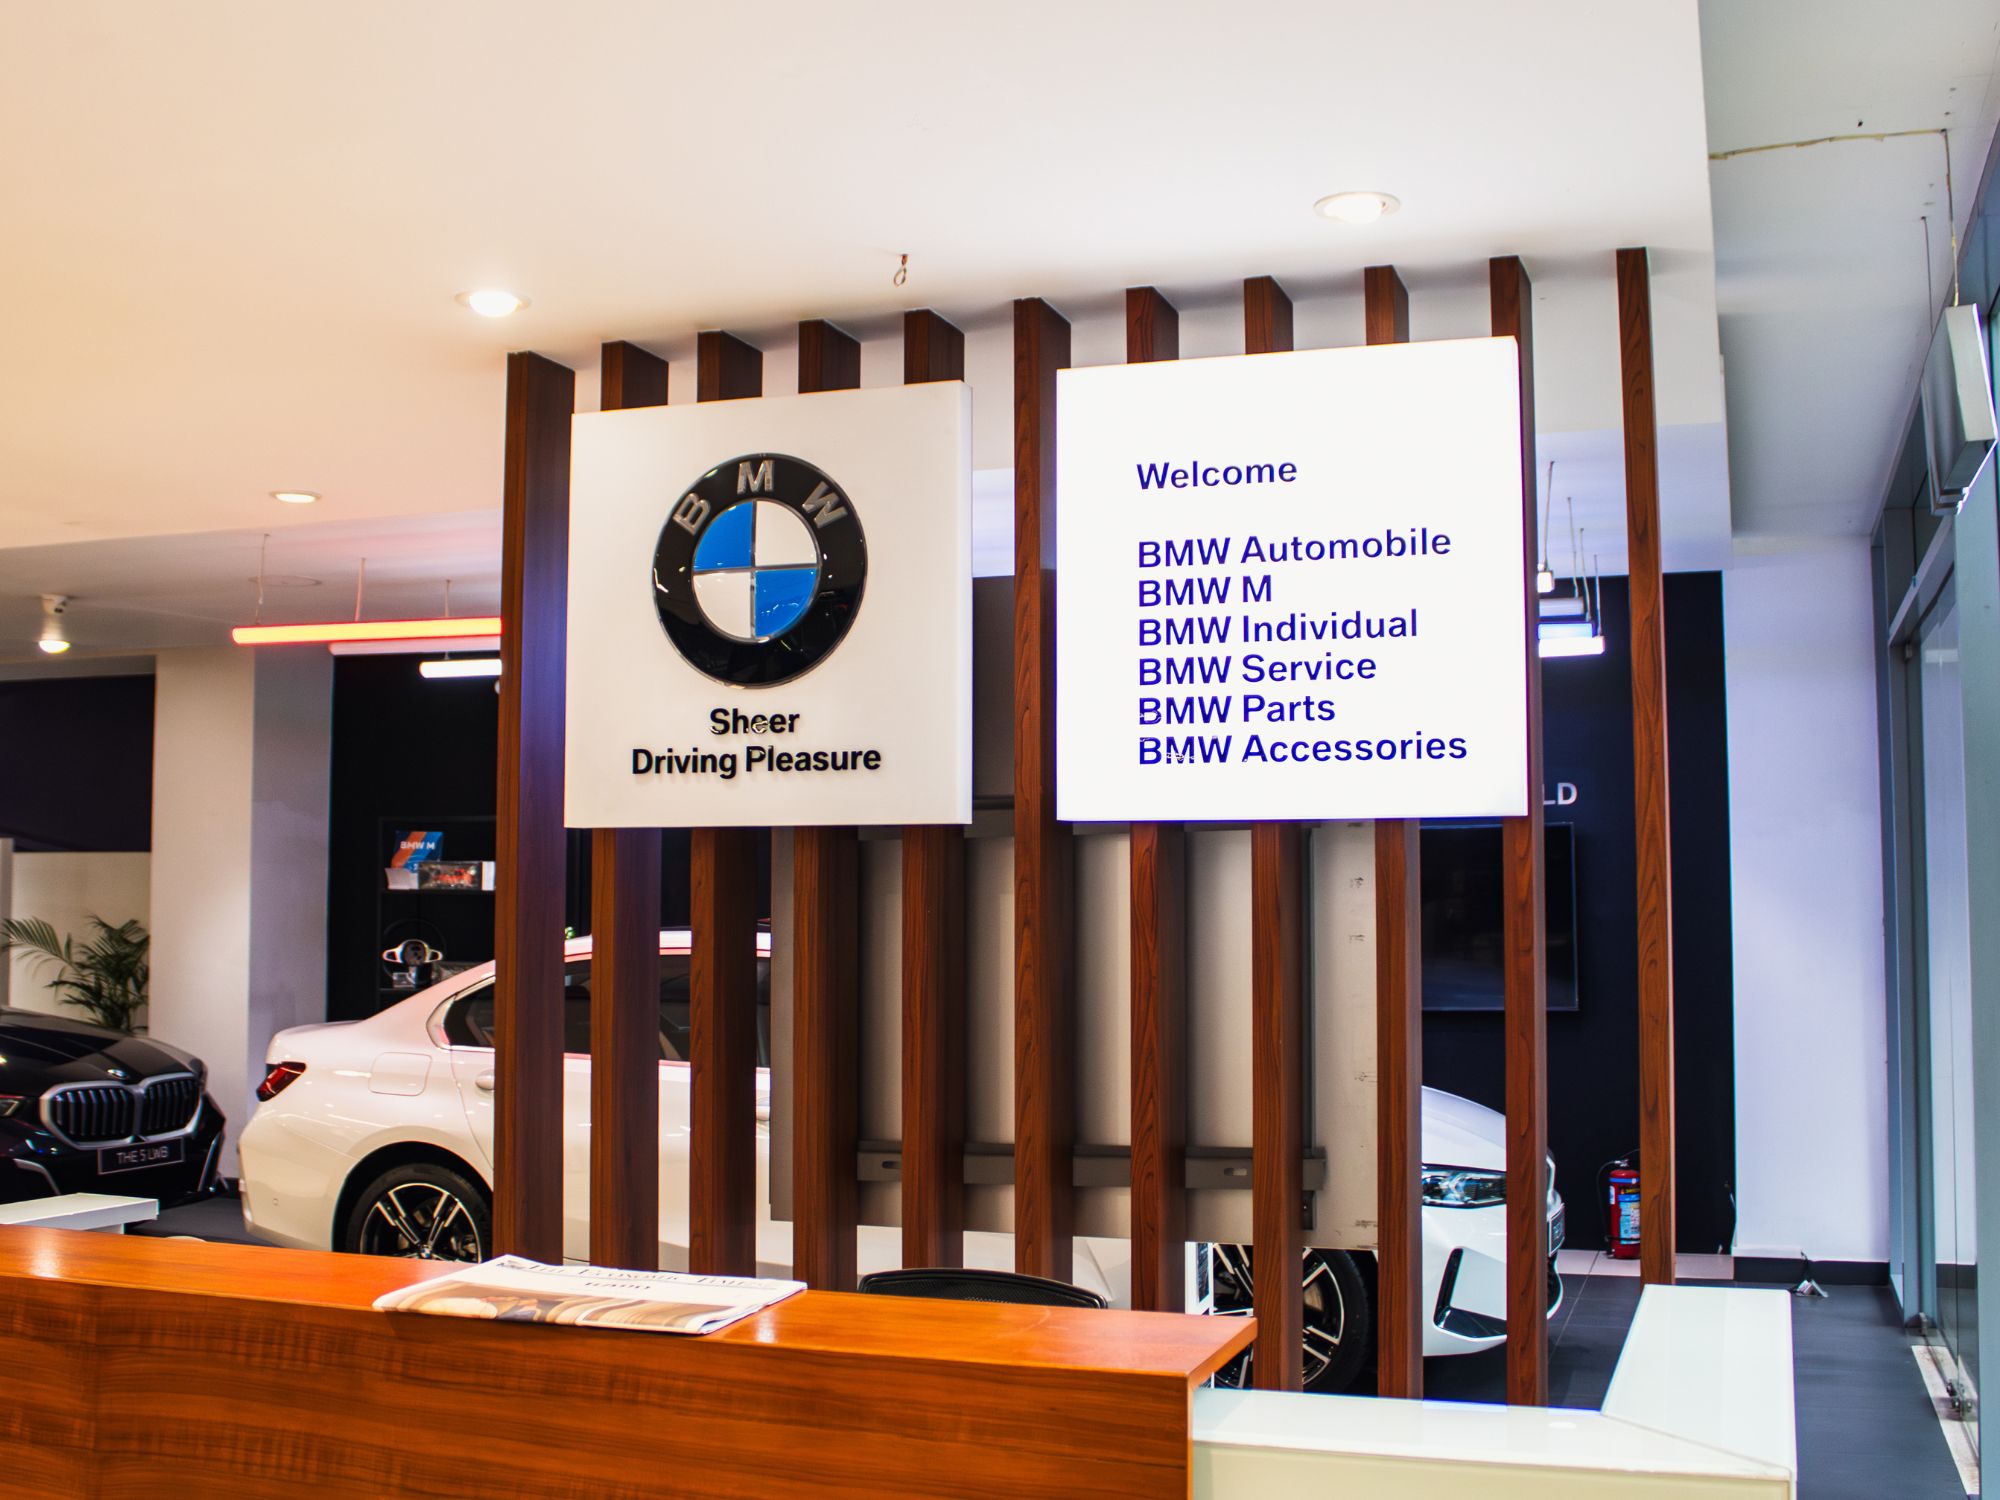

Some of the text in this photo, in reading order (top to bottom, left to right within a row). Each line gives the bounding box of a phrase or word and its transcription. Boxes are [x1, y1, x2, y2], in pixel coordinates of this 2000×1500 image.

[1136, 460, 1298, 490] Welcome
[673, 459, 849, 536] BMW
[1139, 528, 1451, 568] BMW Automobile
[1139, 575, 1272, 607] BMW M
[1139, 609, 1417, 646] BMW Individual
[1139, 652, 1377, 685] BMW Service
[710, 707, 801, 736] Sheer
[1139, 695, 1336, 725] BMW Parts
[632, 745, 883, 780] Driving Pleasure
[1139, 731, 1468, 765] BMW Accessories
[400, 841, 436, 850] BMW M
